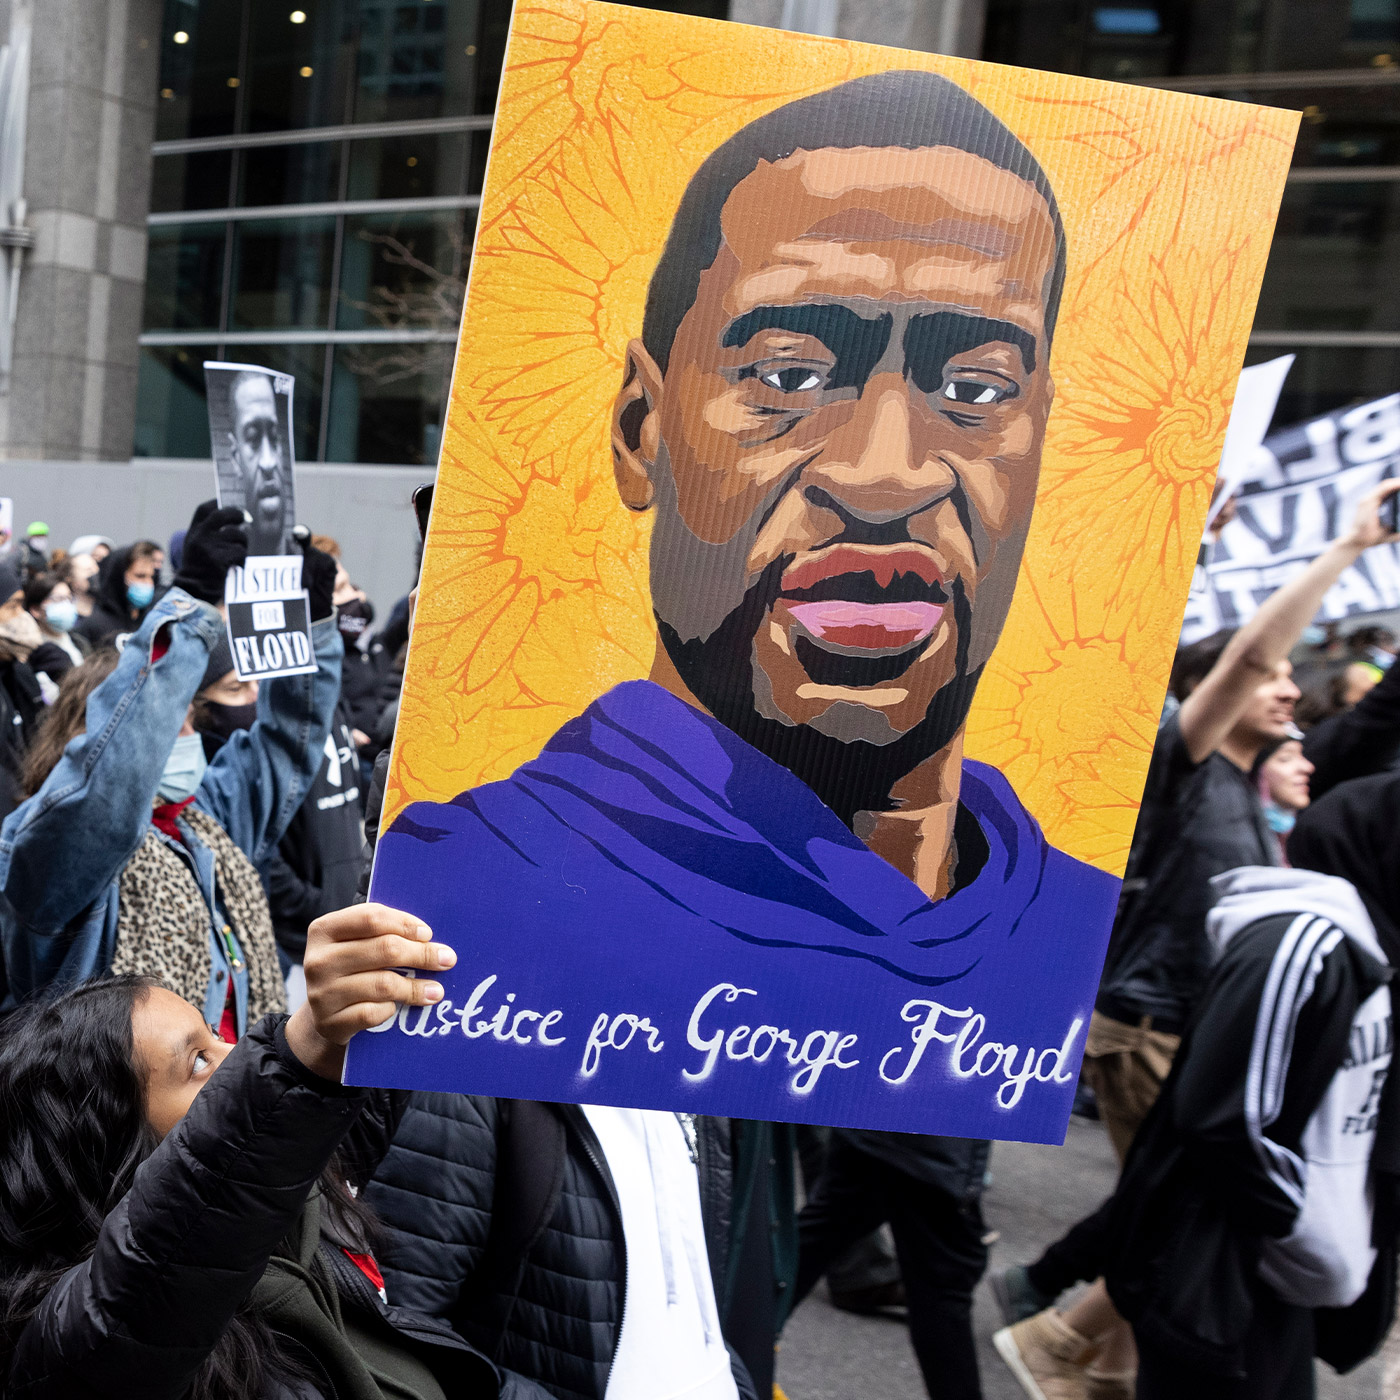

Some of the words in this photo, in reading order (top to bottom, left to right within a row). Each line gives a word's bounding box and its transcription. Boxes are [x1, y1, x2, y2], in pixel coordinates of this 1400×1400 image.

[232, 567, 299, 601] JUSTICE
[258, 608, 280, 625] FOR
[234, 631, 311, 674] FLOYD
[581, 1012, 665, 1078] for
[682, 983, 860, 1096] George
[879, 999, 1084, 1110] Floyd
